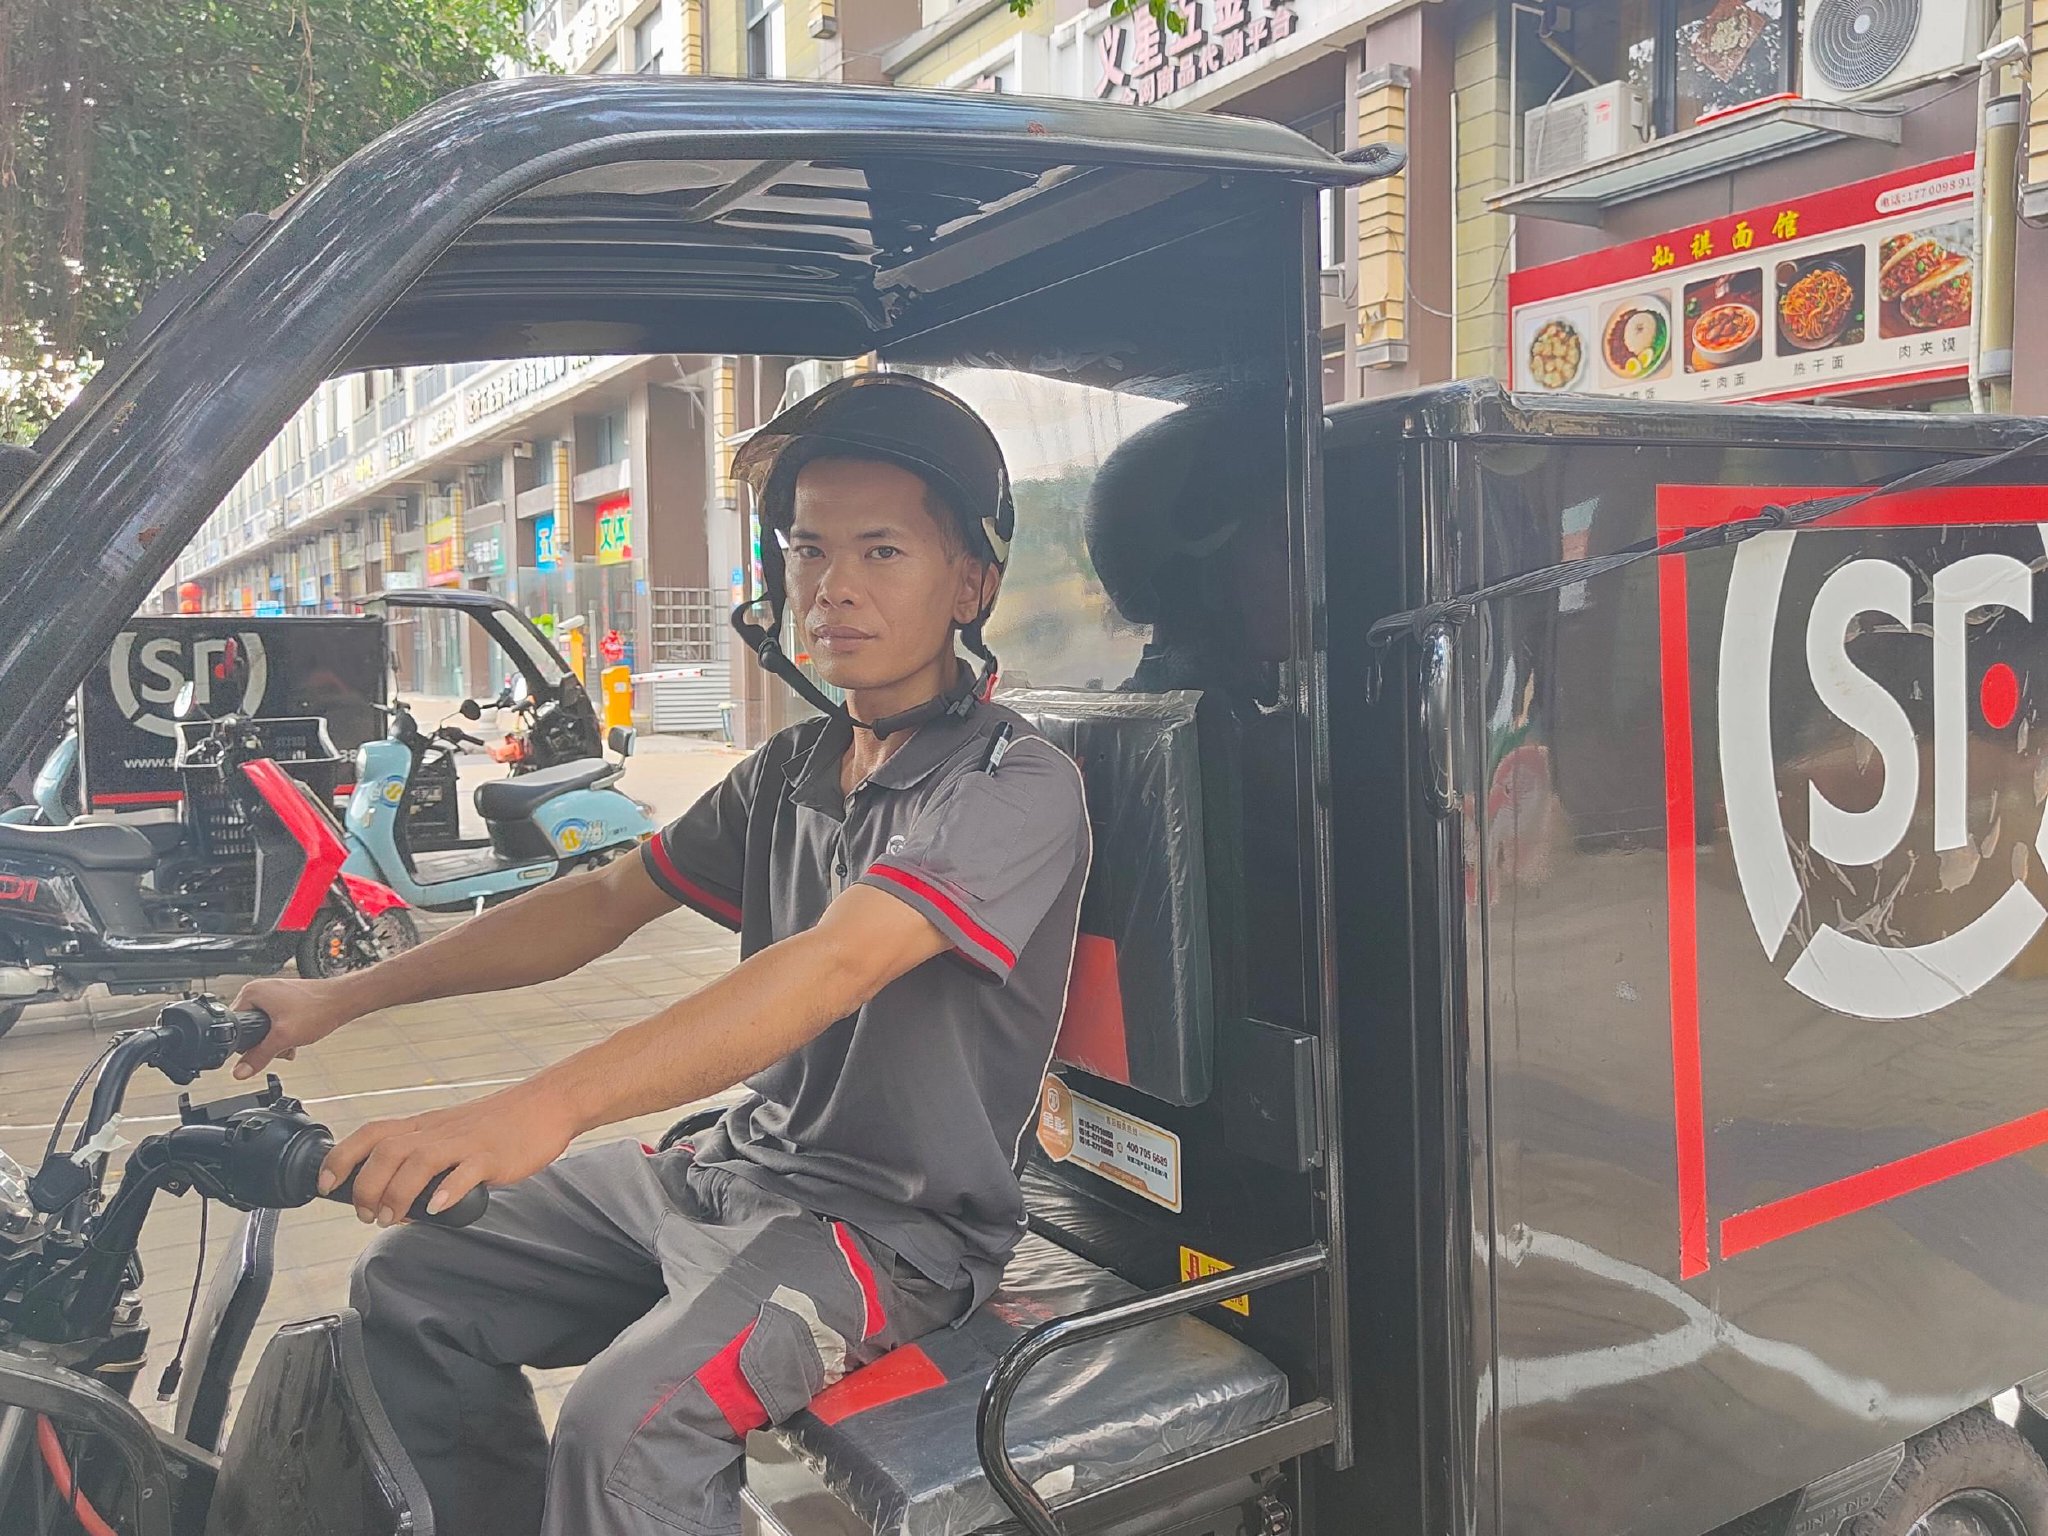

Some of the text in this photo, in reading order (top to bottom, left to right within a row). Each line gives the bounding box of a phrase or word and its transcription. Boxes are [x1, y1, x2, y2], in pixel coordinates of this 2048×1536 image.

[1898, 337, 1956, 359] 肉夹馍
[1792, 354, 1845, 376] 热干面
[1700, 372, 1746, 391] 牛肉面
